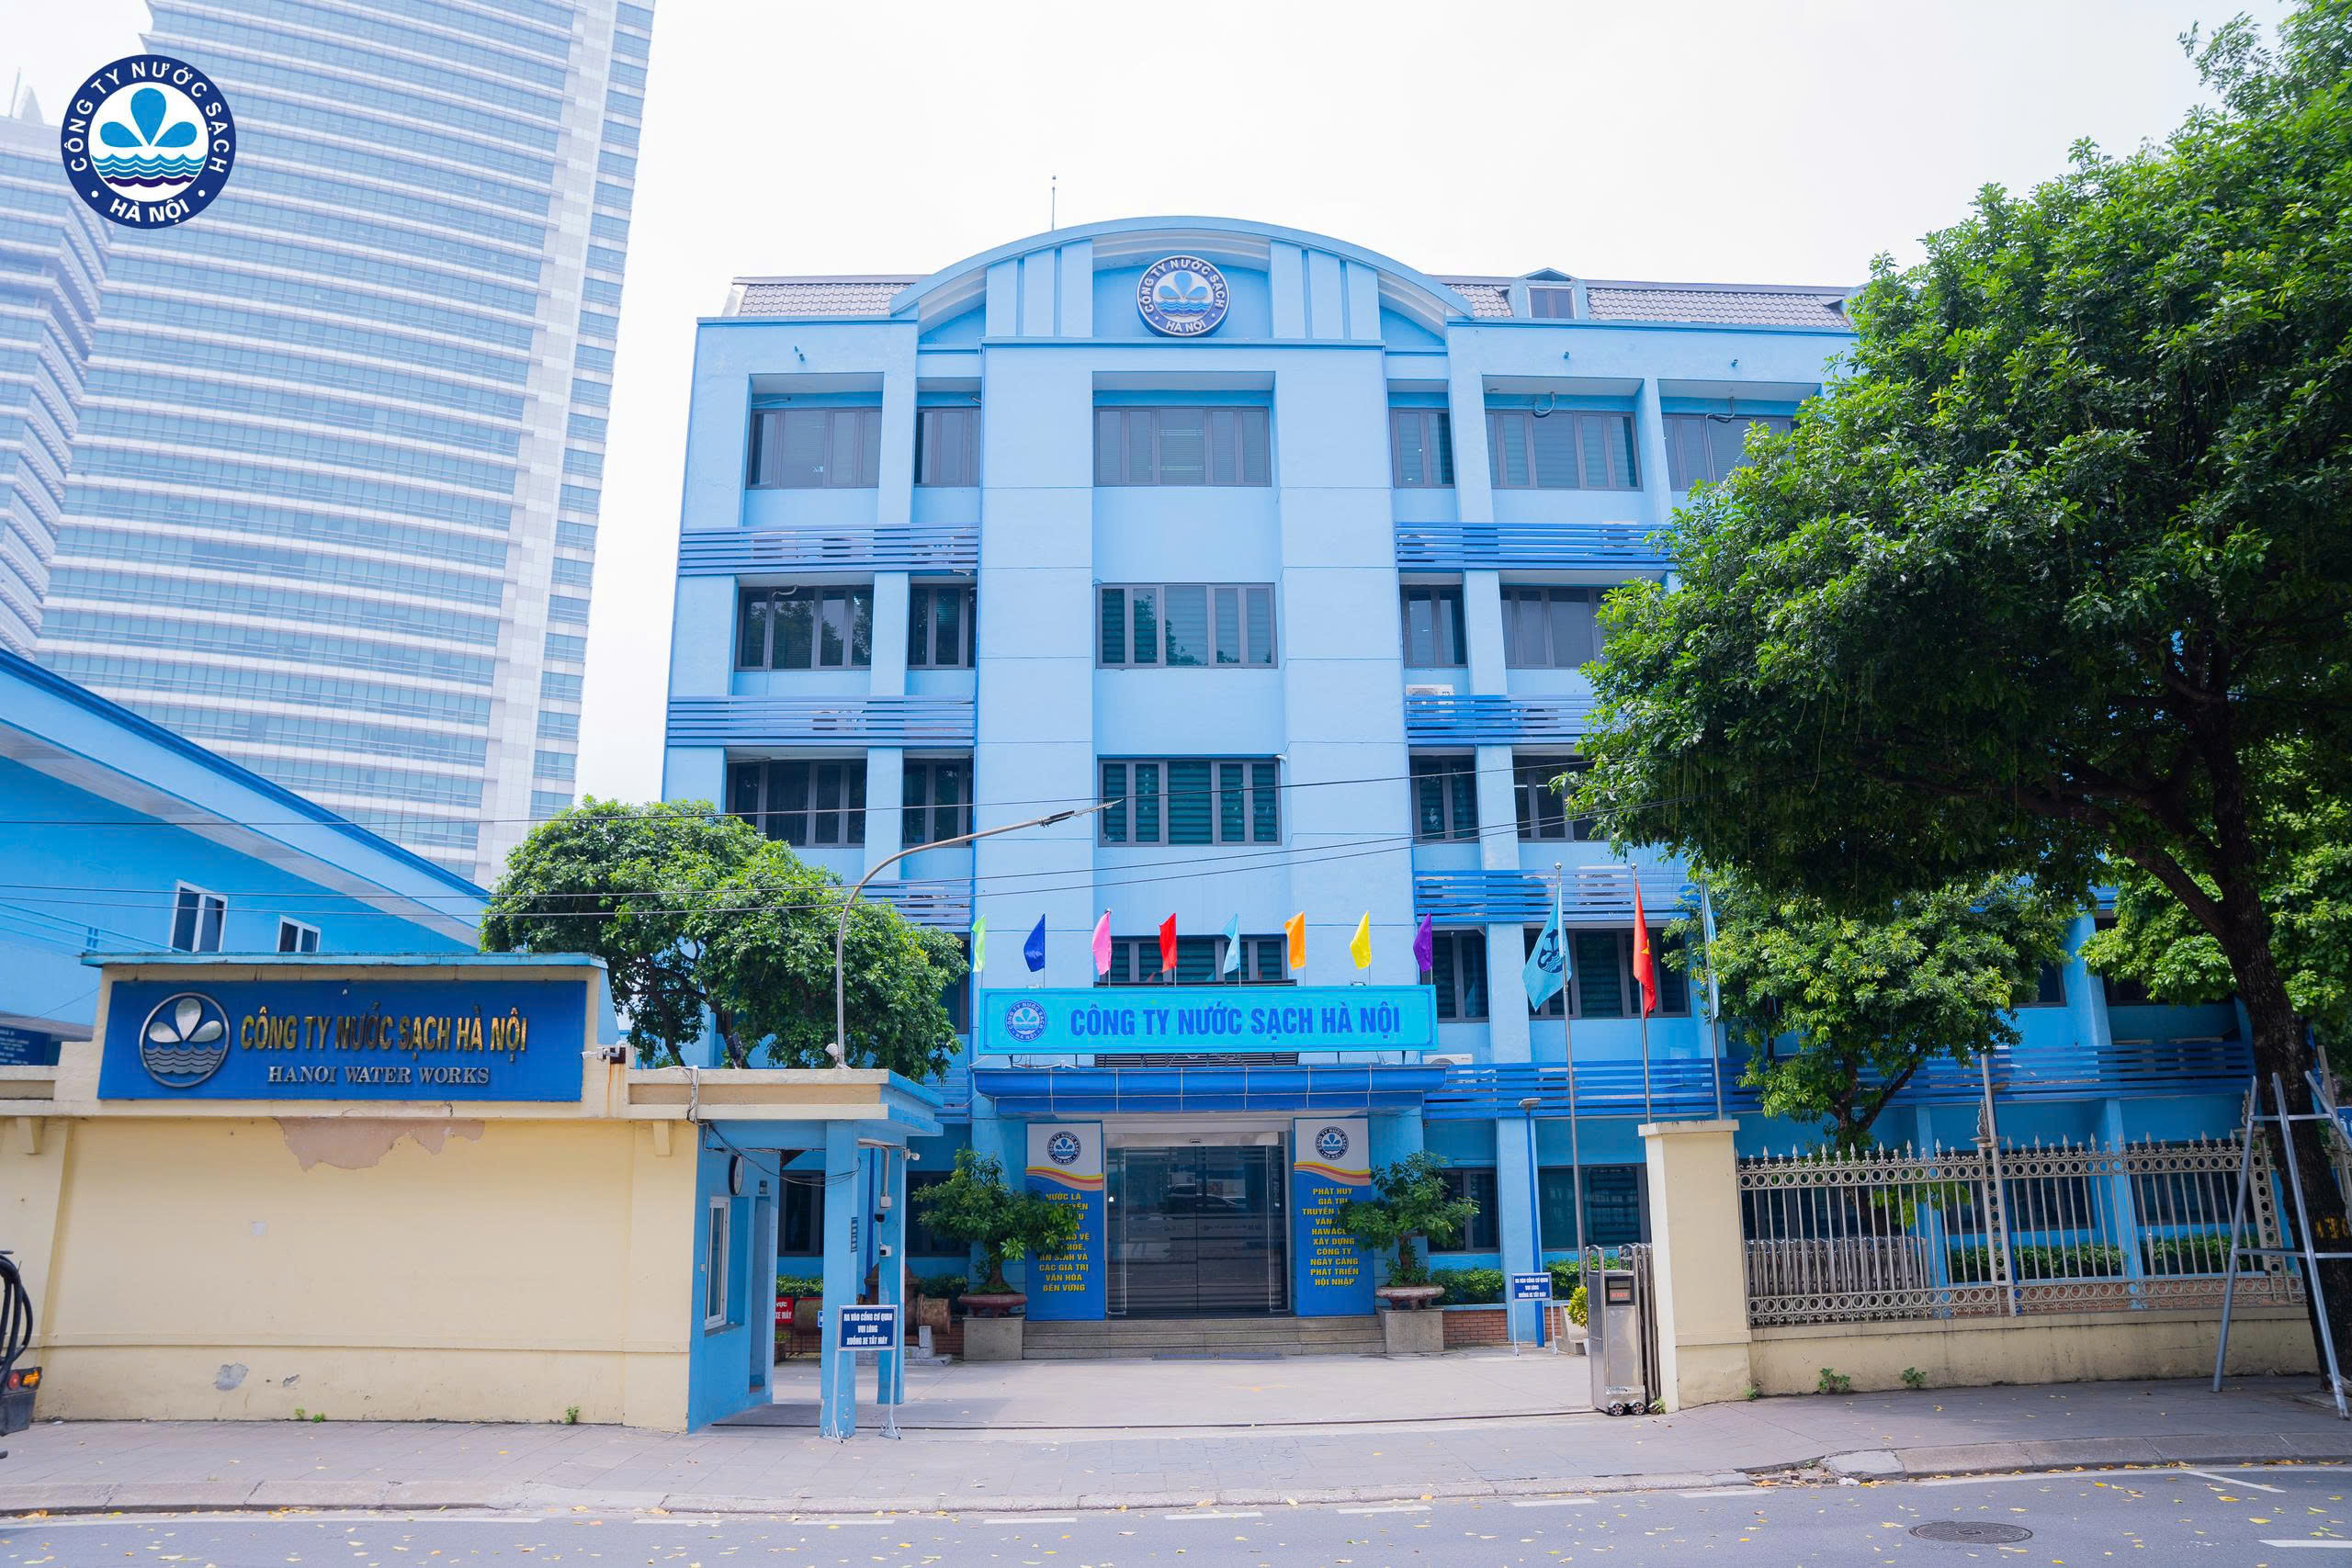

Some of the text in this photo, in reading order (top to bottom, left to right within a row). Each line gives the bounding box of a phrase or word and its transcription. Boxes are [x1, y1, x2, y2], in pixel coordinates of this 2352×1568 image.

[1139, 259, 1226, 314] CÔNG TY NƯỚC SẠCH
[240, 1001, 527, 1062] CÔNG TY NƯỚC SẠCH HÀ NỘI
[1070, 1000, 1400, 1041] CÔNG TY NƯỚC SẠCH HÀ NỘI
[267, 1066, 489, 1084] HANOI WATER WORKS
